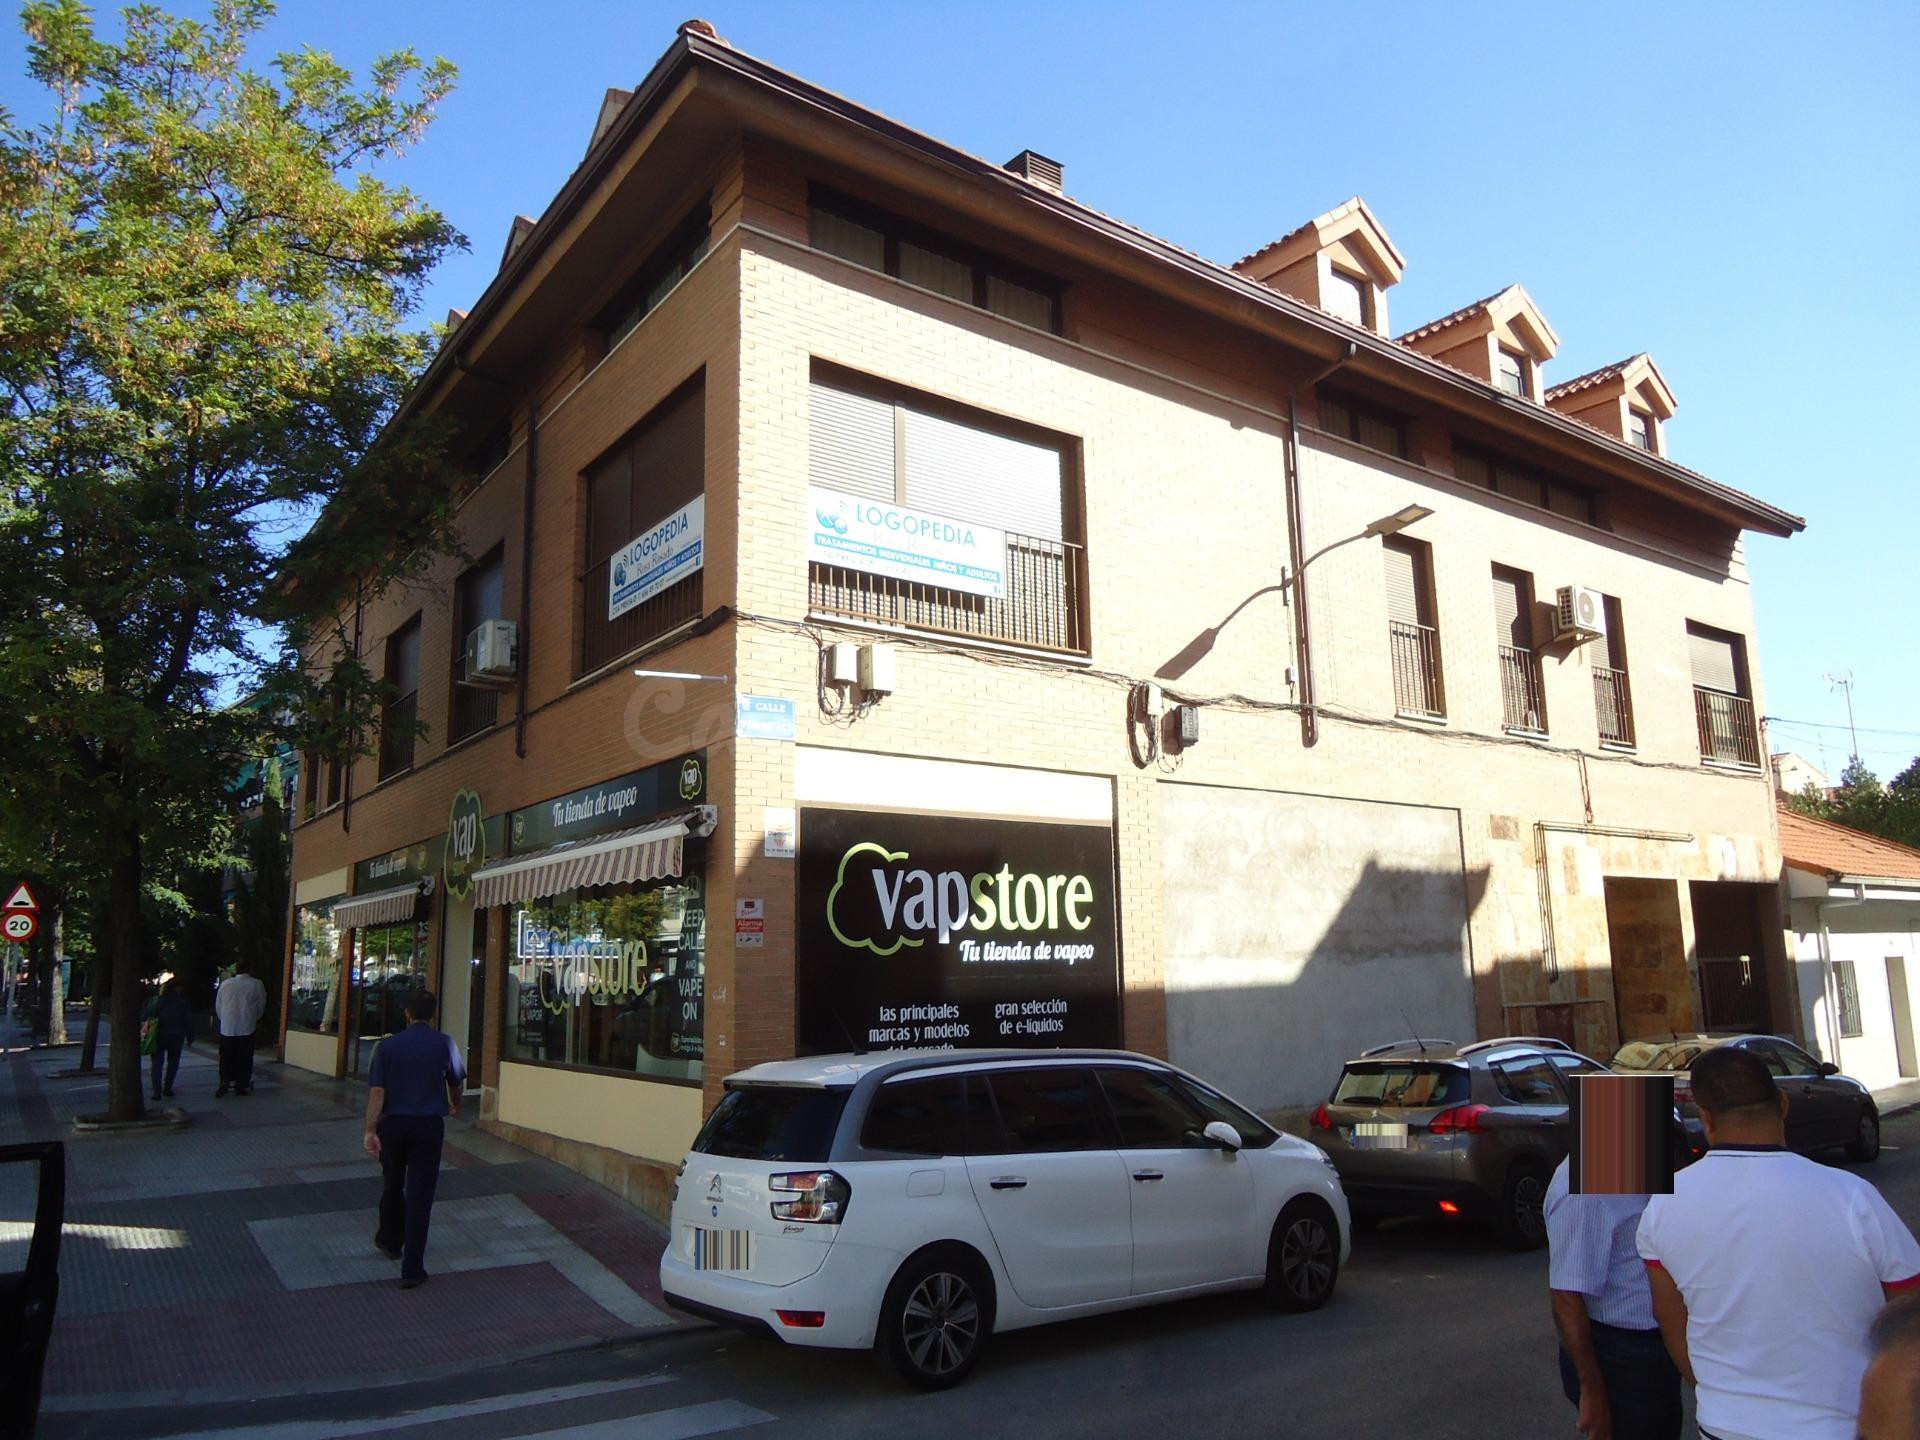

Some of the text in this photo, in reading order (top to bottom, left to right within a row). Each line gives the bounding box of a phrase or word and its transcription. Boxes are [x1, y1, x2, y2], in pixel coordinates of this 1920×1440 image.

[856, 502, 975, 548] LOGOPEDIA
[630, 510, 688, 566] LOGOPEDIA
[681, 542, 699, 562] ADULTOS
[816, 535, 876, 556] TRATAMIENTOS
[879, 548, 930, 567] INDIVIDUALES
[965, 567, 997, 581] ADULTOS
[755, 702, 786, 713] CALLE
[683, 767, 697, 786] vap
[553, 786, 637, 827] Tu tienda de vapeo
[453, 813, 476, 863] vap
[872, 863, 1093, 944] vapstore
[10, 921, 29, 931] 20
[960, 940, 1094, 965] Tu tienda de vapeo
[552, 939, 648, 1007] vapstore
[685, 959, 697, 969] AND
[678, 978, 703, 997] VAPE
[682, 1002, 697, 1020] ON
[879, 1003, 959, 1023] las principales
[994, 999, 1067, 1019] gran selección
[868, 1023, 970, 1043] marcas y modelos
[999, 1019, 1013, 1035] de
